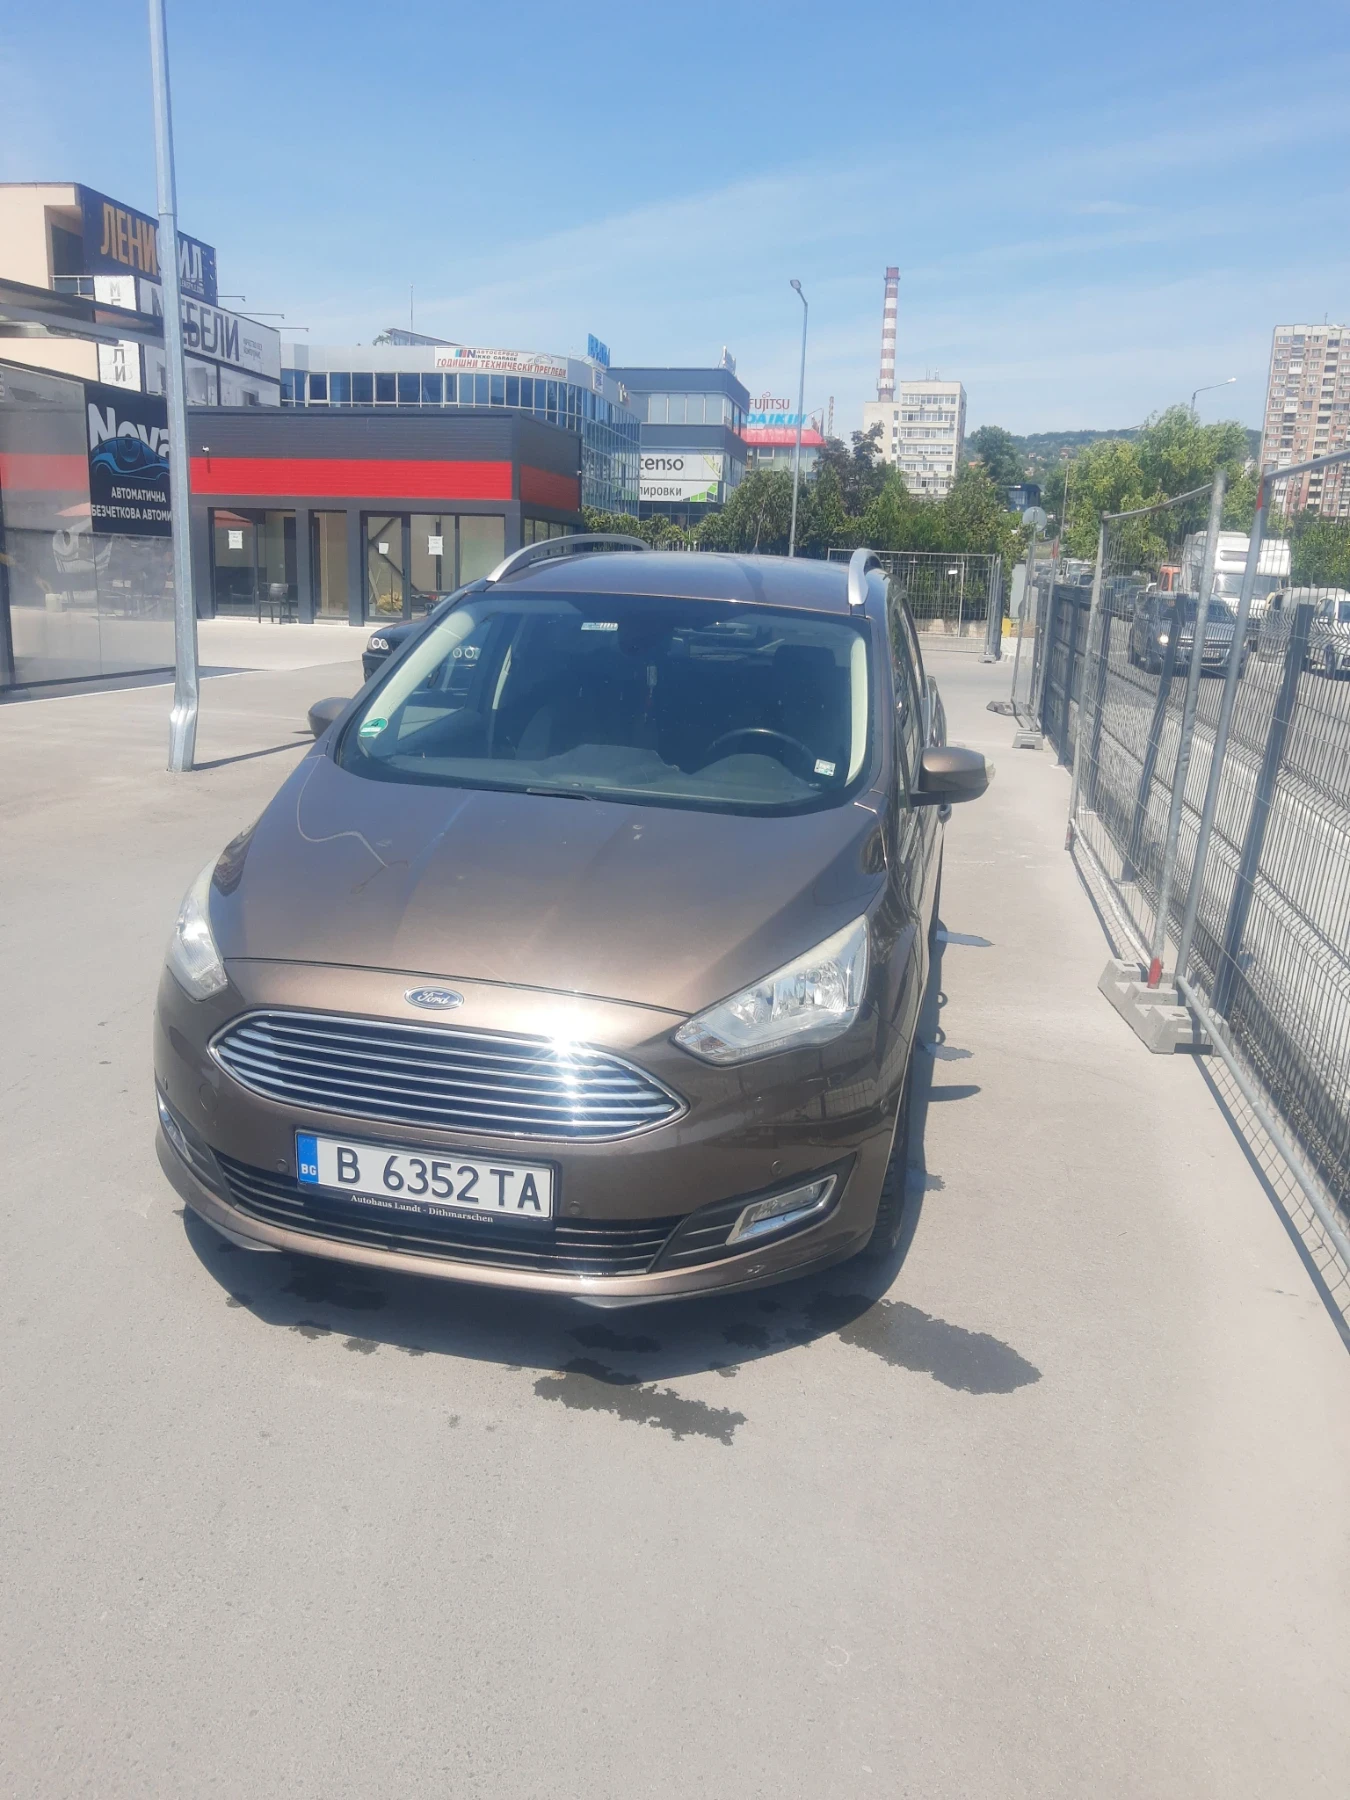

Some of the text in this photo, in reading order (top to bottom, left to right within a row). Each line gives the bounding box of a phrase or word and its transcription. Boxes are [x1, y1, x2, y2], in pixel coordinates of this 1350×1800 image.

[101, 202, 204, 283] ЛЕНИИЛ
[437, 358, 566, 377] ГОДИШНИ ТЕХНИЧЕСКИ ПРЕГЛЕДИ
[747, 413, 807, 424] DAIKIN
[111, 486, 167, 503] АВТОМАТИЧНА
[91, 504, 141, 520] БЕЗЧЕТКОВА
[301, 1163, 317, 1176] BG
[337, 1147, 541, 1211] B 6352 TA
[350, 1194, 393, 1208] Autohaus
[394, 1202, 421, 1213] Lundt
[428, 1207, 494, 1223] Dithmarschen
